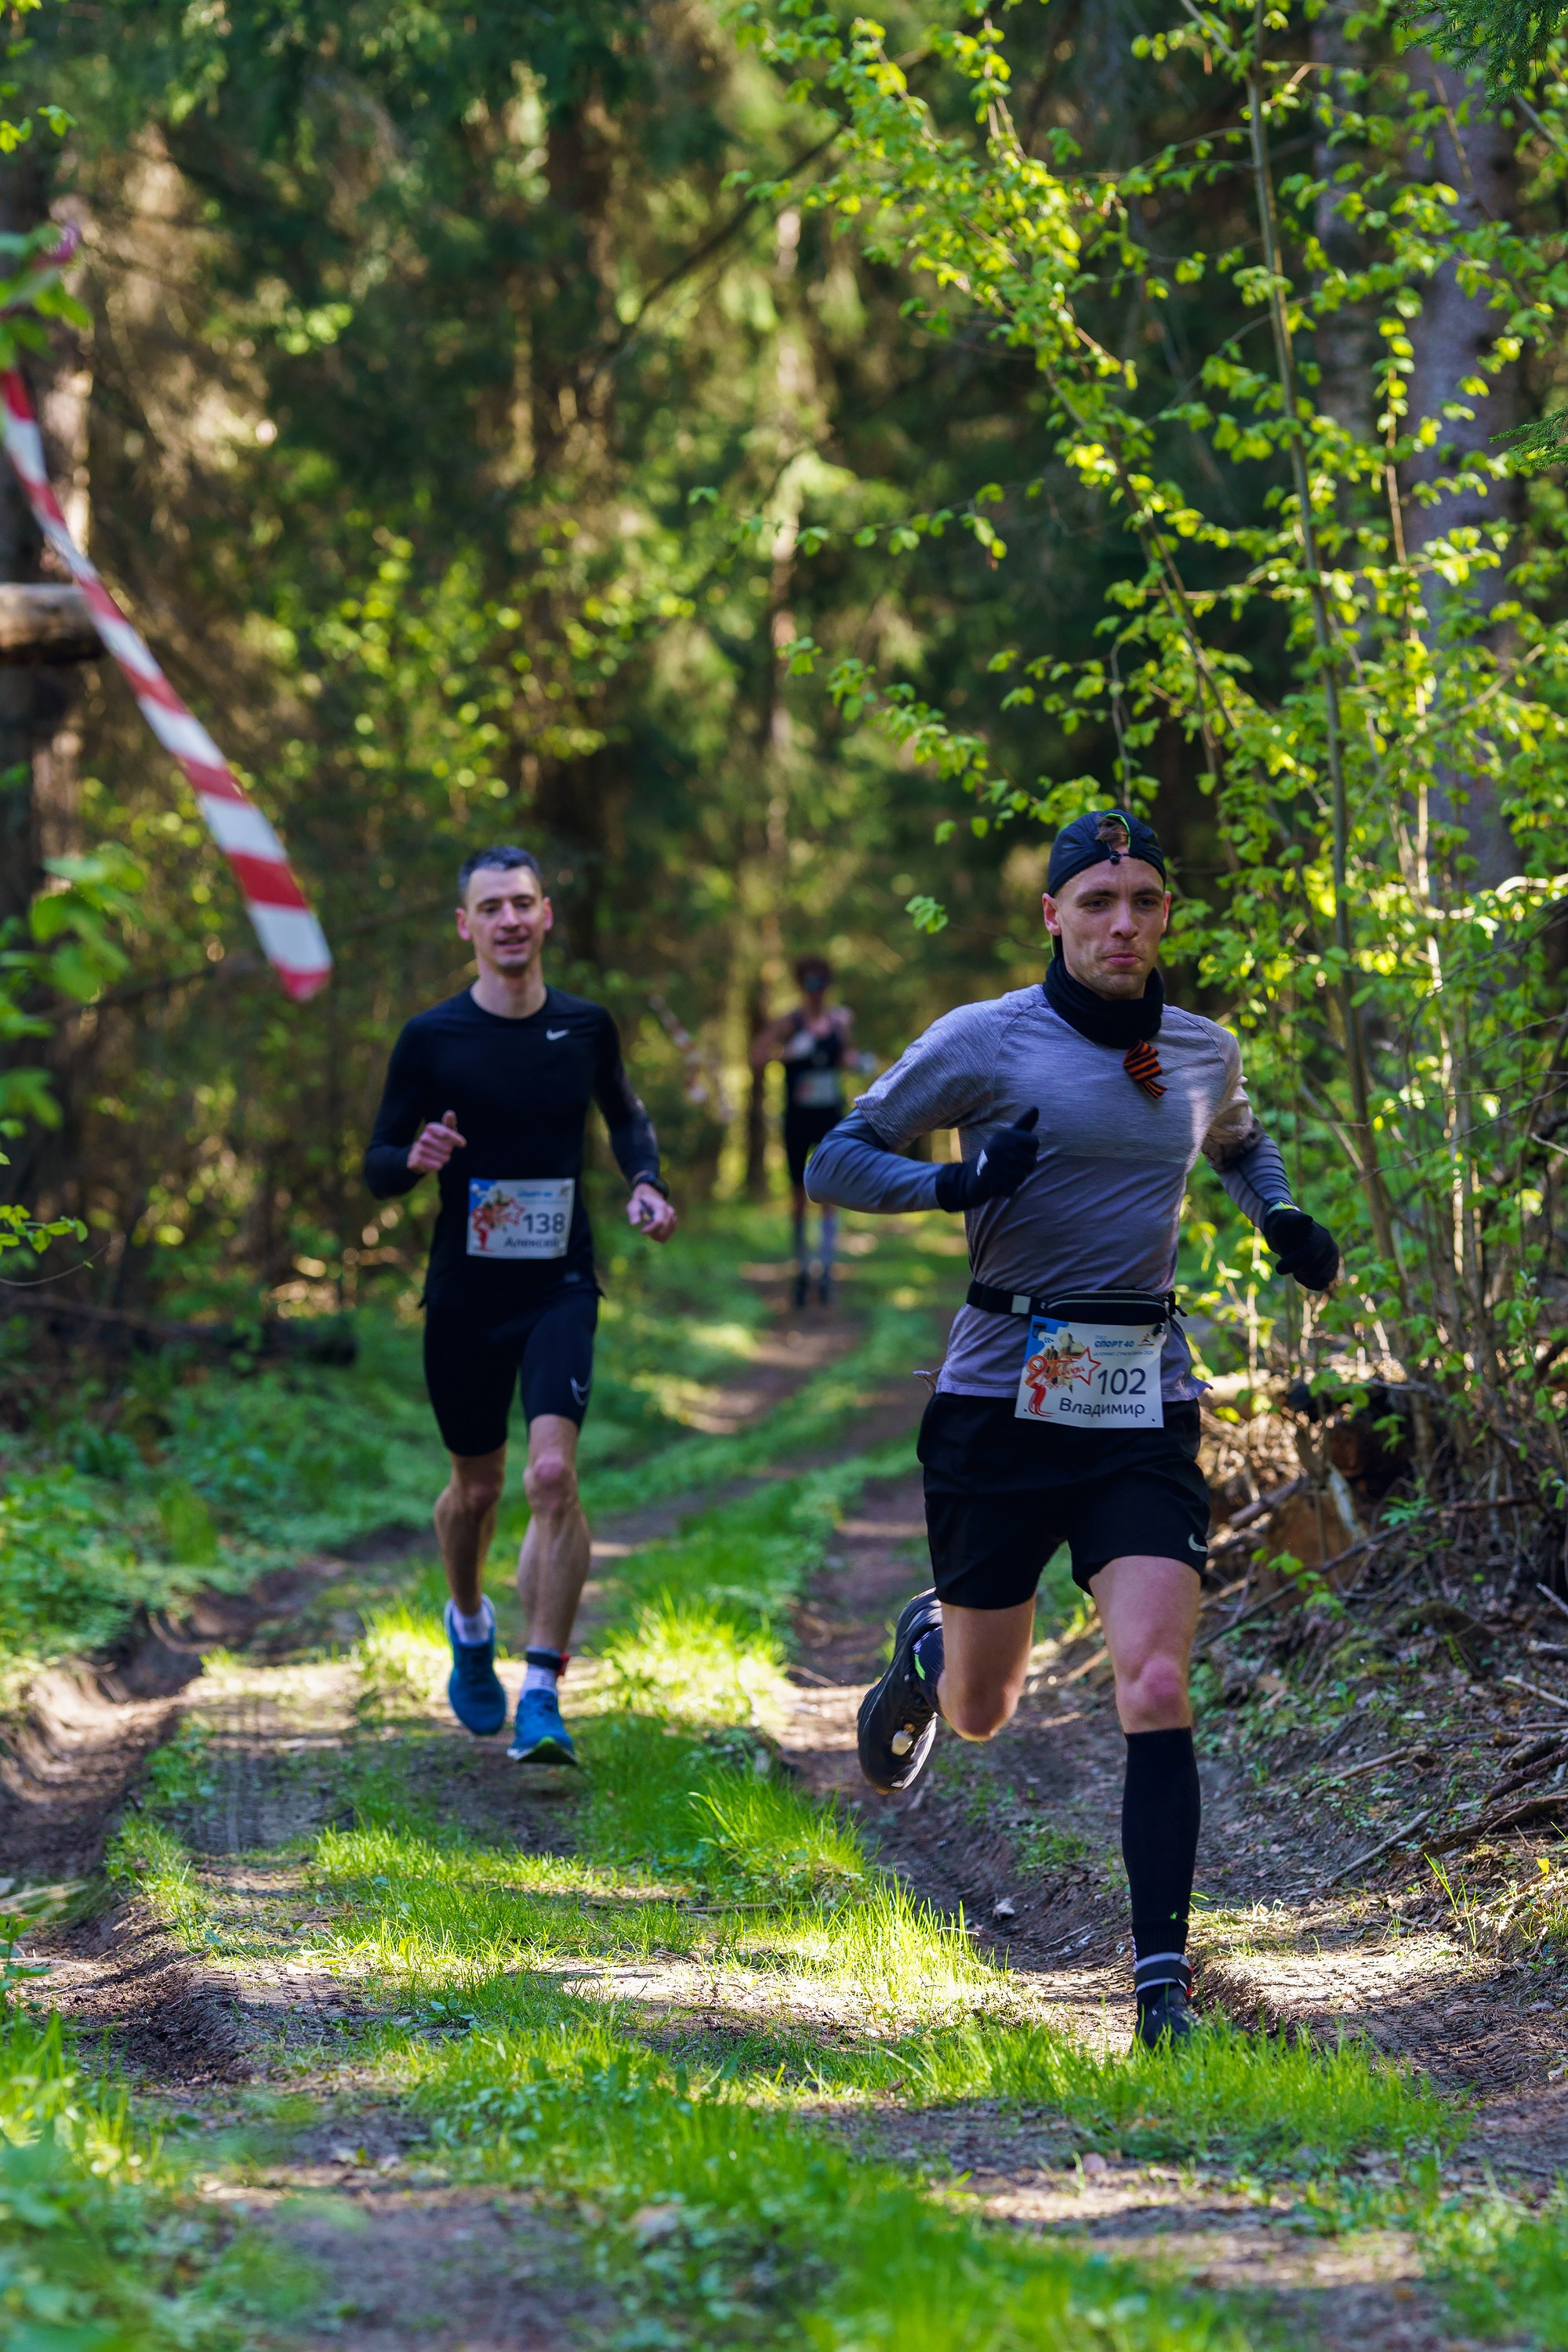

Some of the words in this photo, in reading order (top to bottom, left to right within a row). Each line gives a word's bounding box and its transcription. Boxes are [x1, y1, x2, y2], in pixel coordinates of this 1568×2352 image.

[523, 1212, 565, 1234] 138
[1098, 1368, 1146, 1395] 102
[1059, 1398, 1145, 1417] Владимир
